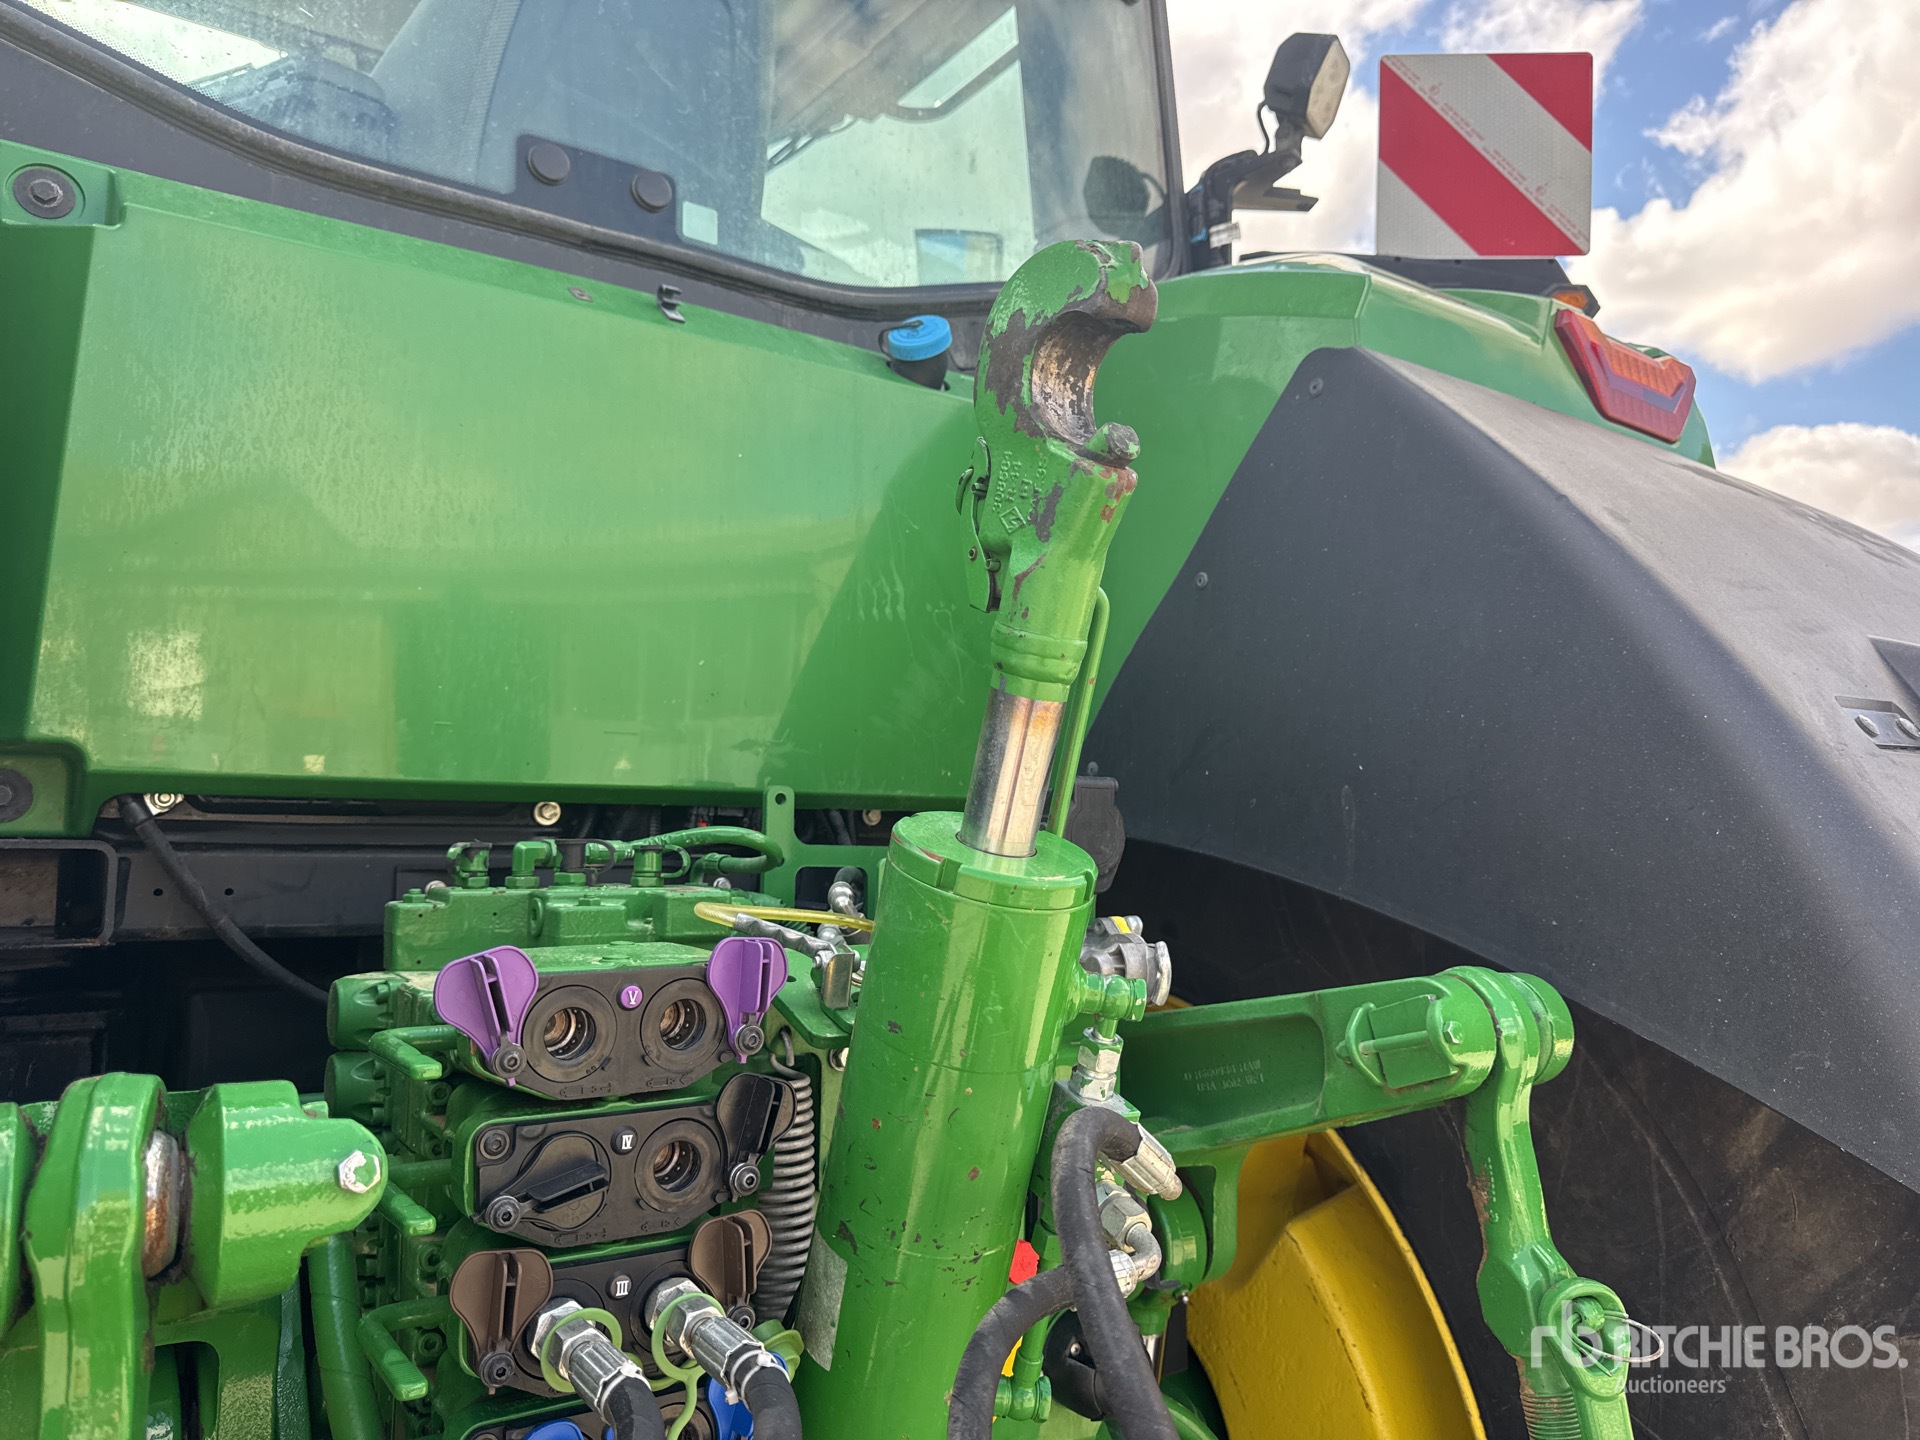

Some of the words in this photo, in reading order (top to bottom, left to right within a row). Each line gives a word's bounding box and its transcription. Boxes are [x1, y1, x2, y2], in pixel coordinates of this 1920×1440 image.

[628, 990, 639, 1005] V
[621, 1134, 634, 1150] IV
[615, 1280, 630, 1297] III
